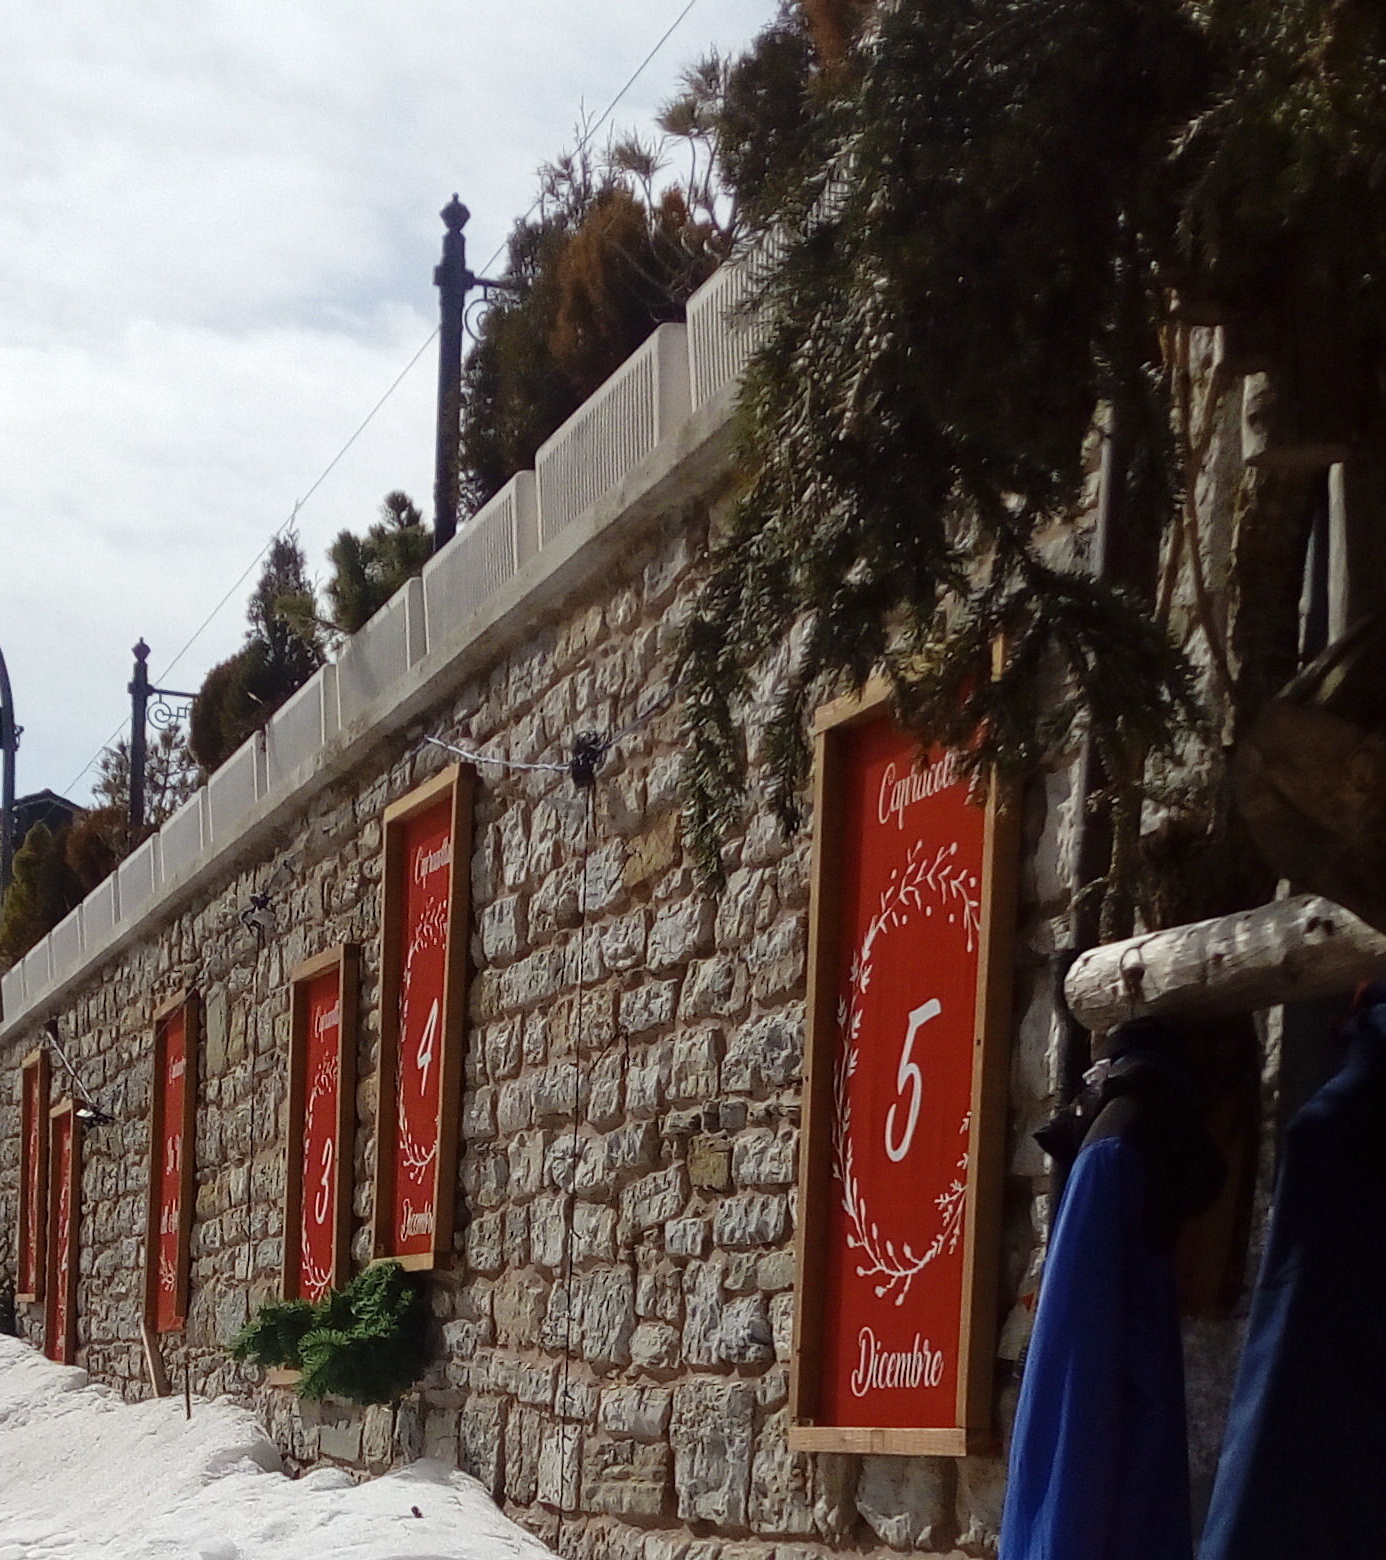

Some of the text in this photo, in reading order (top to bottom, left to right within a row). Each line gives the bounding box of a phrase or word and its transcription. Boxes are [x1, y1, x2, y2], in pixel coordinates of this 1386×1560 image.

[416, 997, 439, 1096] 4
[884, 997, 942, 1162] 5
[315, 1137, 333, 1225] 3
[851, 1326, 945, 1397] Dicembre
